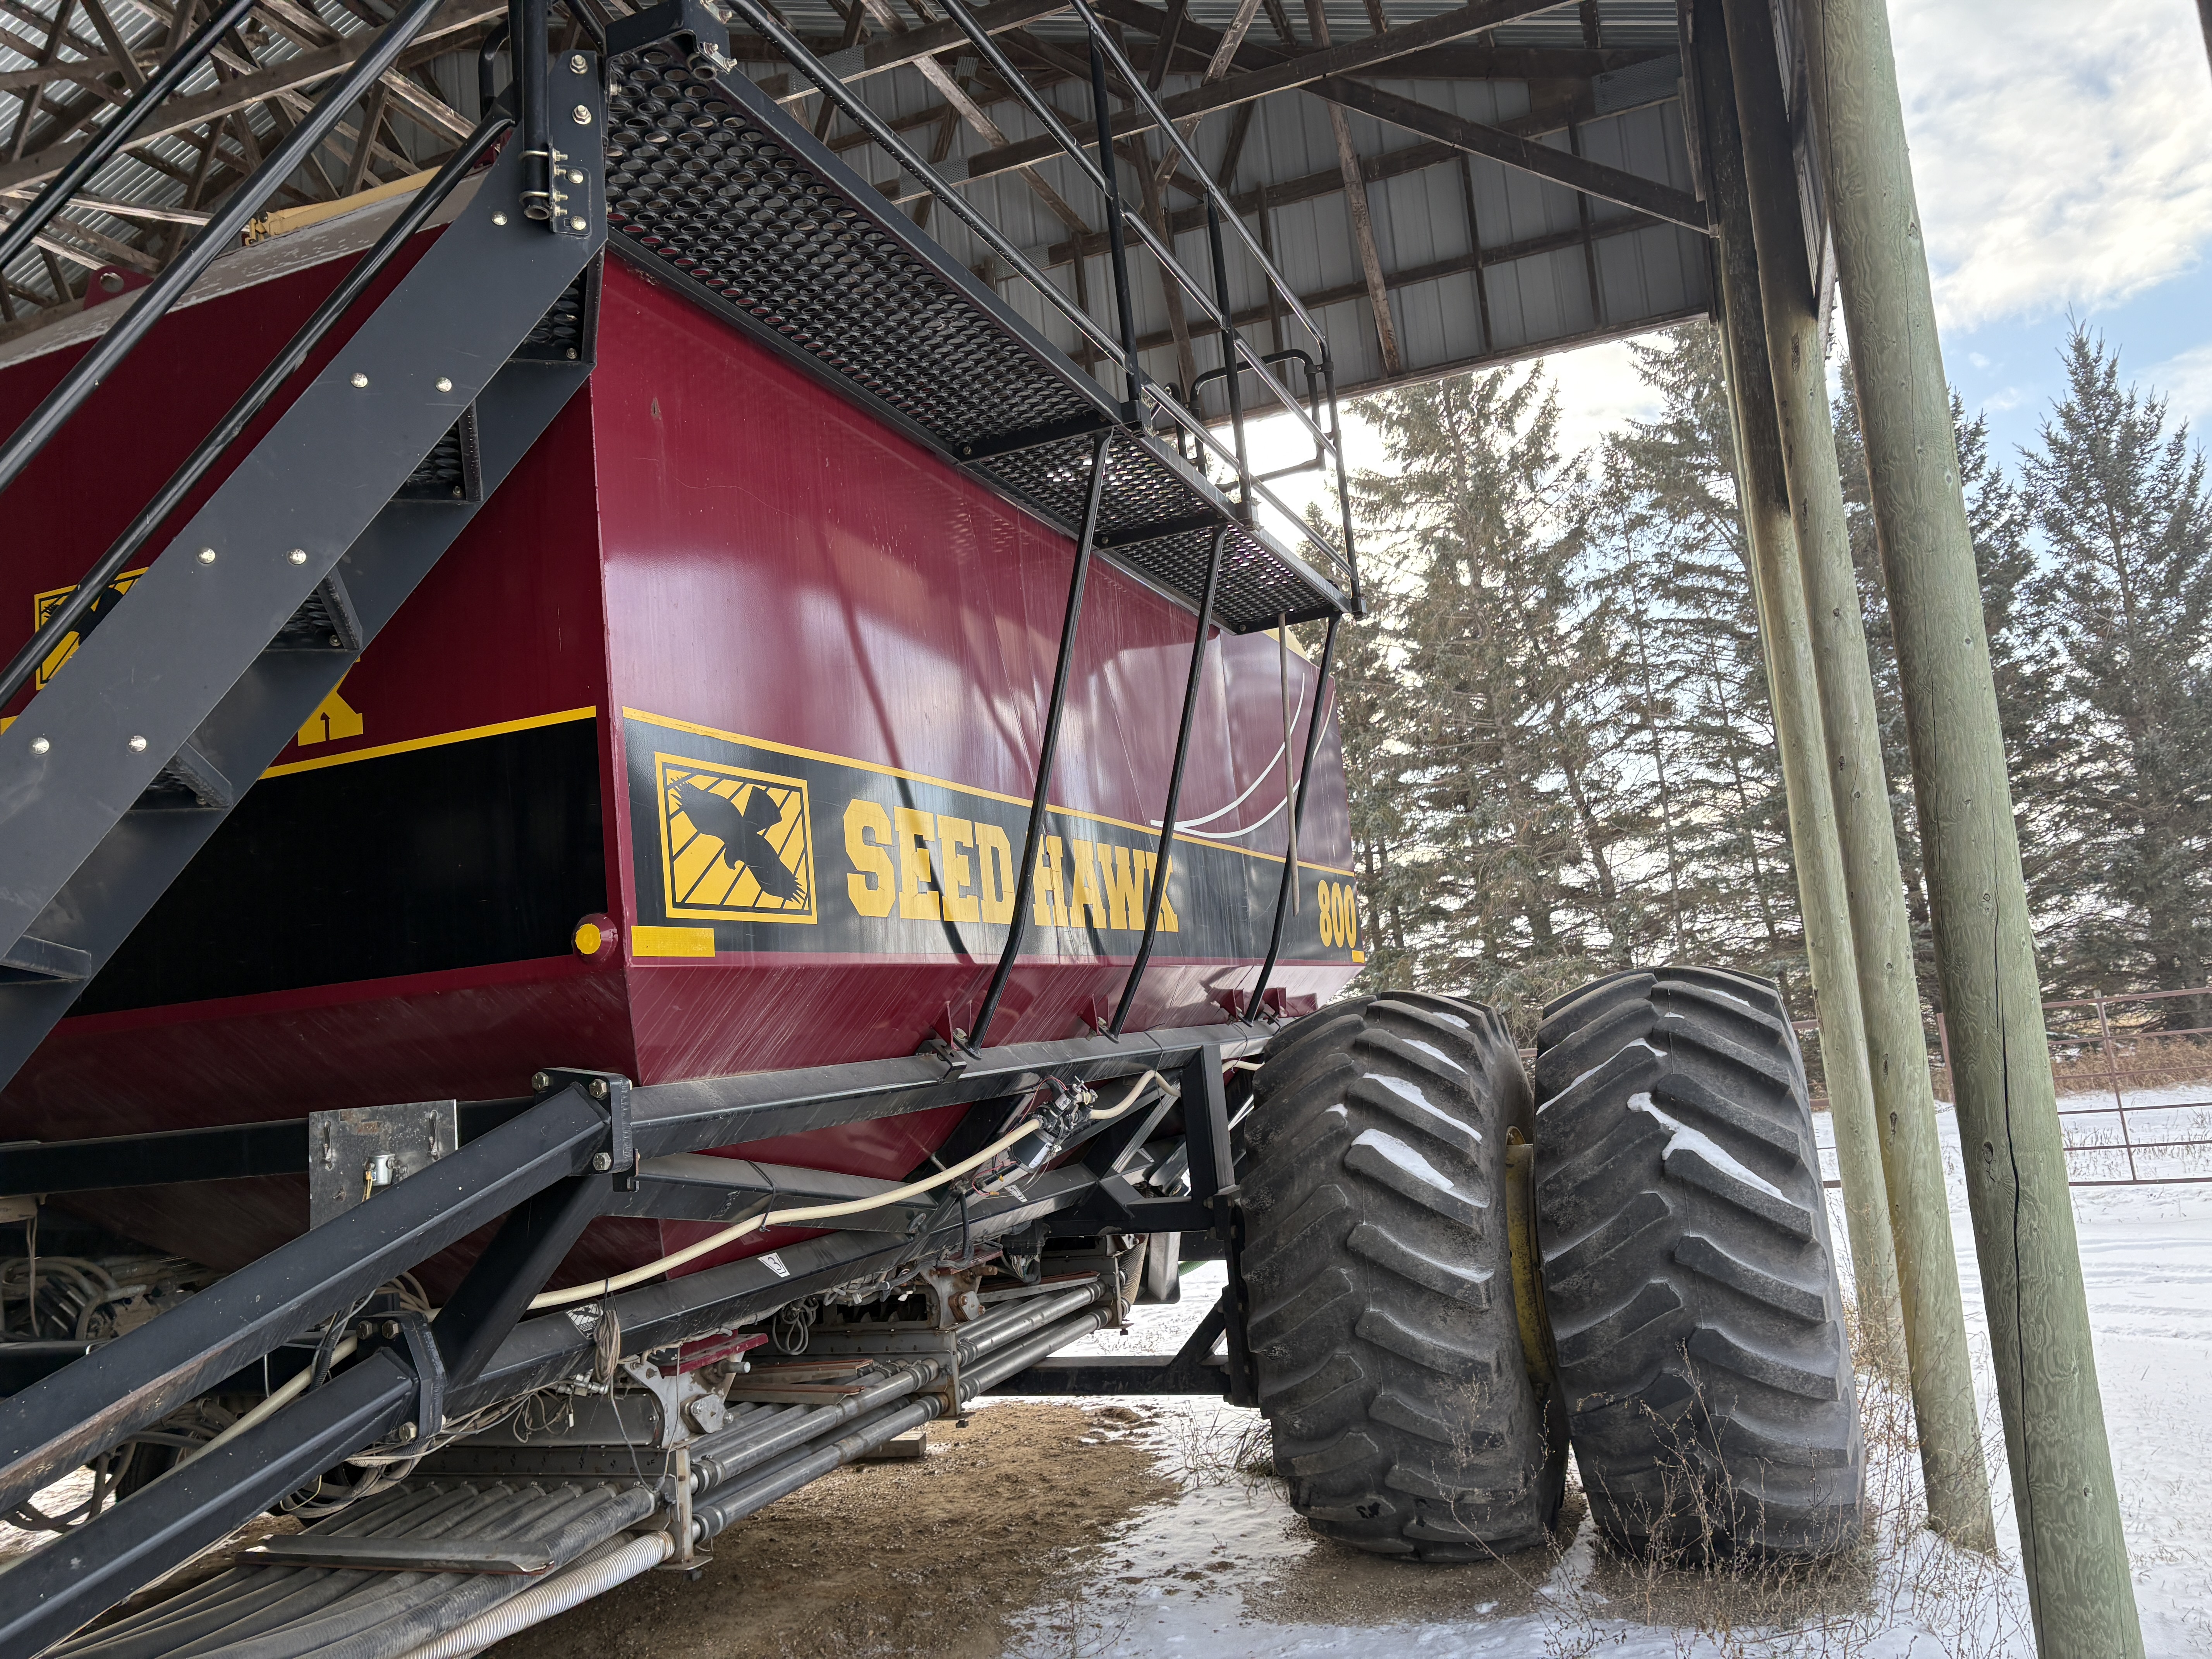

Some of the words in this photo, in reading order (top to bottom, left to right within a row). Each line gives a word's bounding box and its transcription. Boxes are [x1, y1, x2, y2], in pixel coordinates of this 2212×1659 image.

[843, 799, 1015, 924] SEED
[1027, 831, 1179, 932] HAWK
[1317, 879, 1357, 949] 800
[768, 1257, 782, 1271] 3
